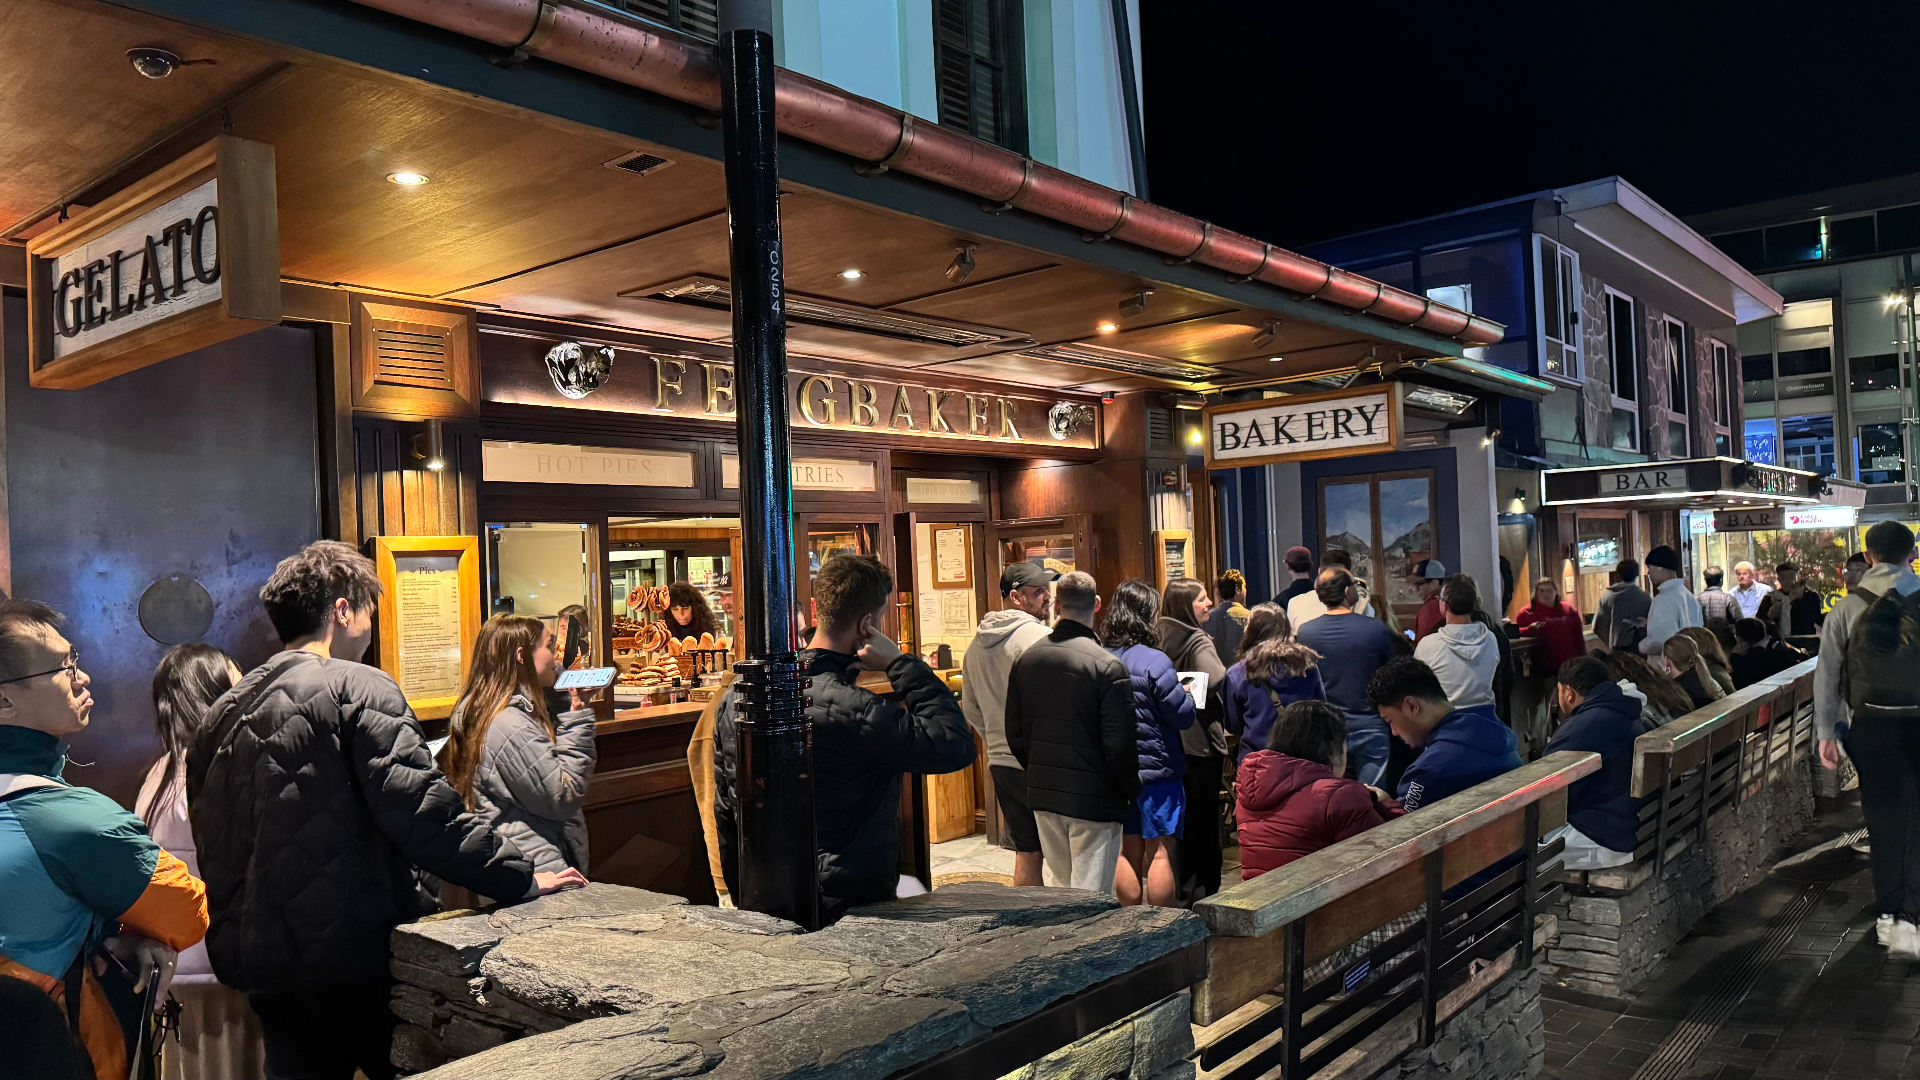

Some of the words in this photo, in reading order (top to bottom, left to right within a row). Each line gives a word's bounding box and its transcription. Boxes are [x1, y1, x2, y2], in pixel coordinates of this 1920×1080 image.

[56, 205, 221, 338] GELATO
[770, 250, 781, 315] 0254
[650, 356, 1025, 442] FEGBAKER
[1217, 403, 1385, 451] BAKERY
[536, 454, 589, 474] HOT
[601, 457, 653, 476] PIES
[1616, 471, 1672, 490] BAR
[919, 485, 968, 498] BREADS
[1728, 513, 1770, 527] BAR
